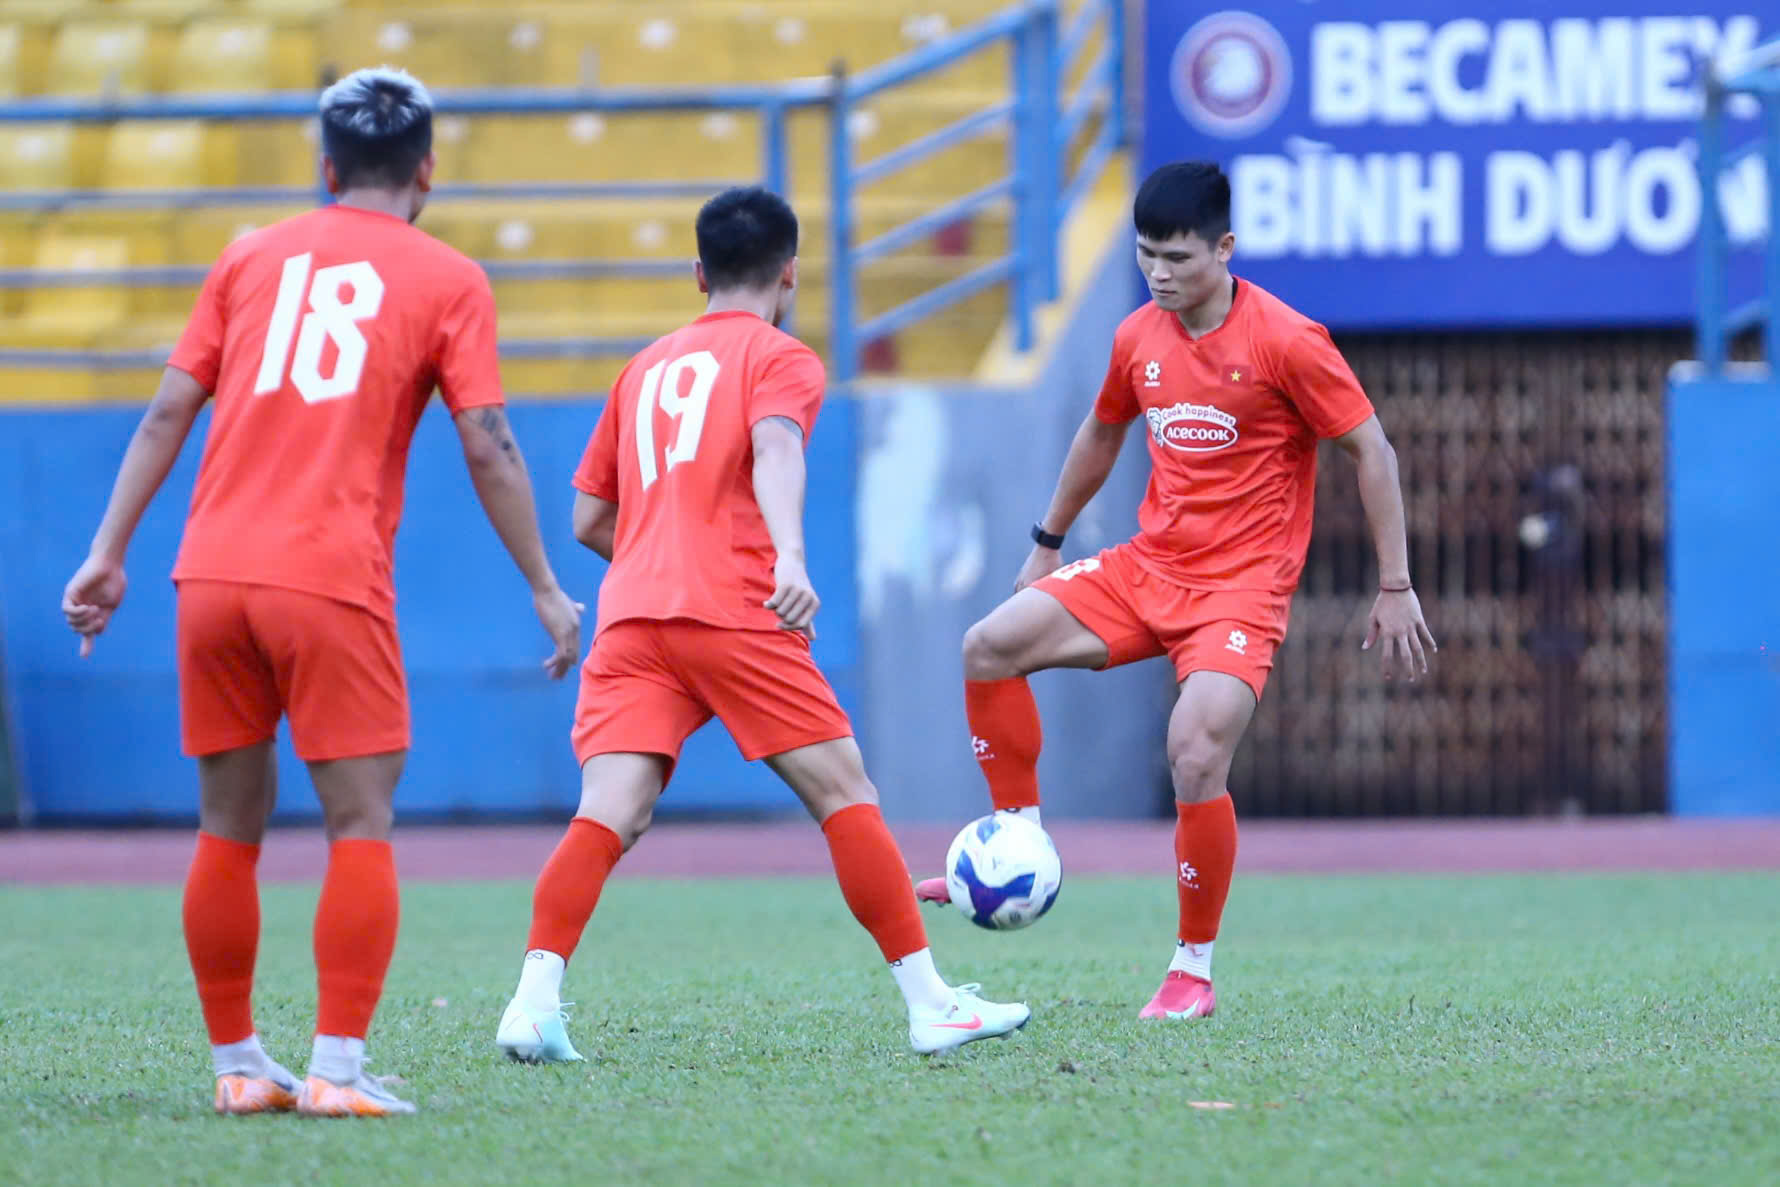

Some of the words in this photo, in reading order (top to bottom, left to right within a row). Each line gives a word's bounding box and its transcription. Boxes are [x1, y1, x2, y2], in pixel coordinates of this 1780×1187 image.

[1231, 135, 1462, 257] BÌNH
[254, 252, 385, 405] 18
[636, 350, 720, 491] 19
[1163, 404, 1182, 420] Cook
[1185, 404, 1234, 425] happiness
